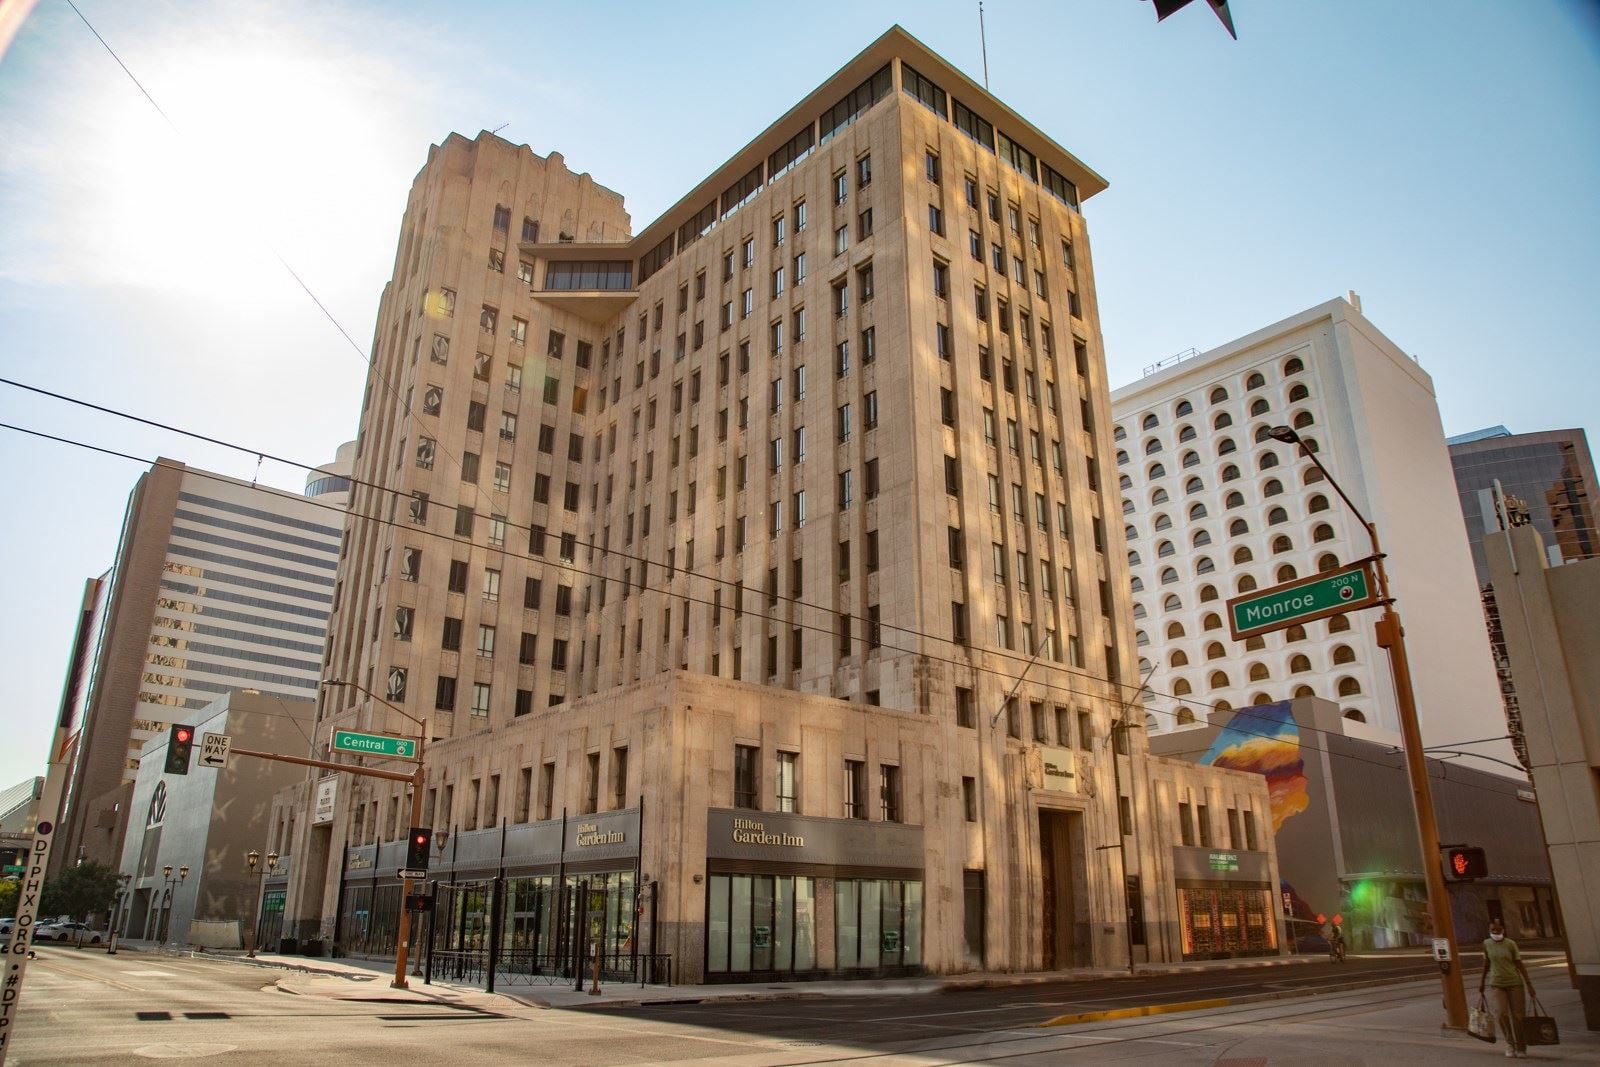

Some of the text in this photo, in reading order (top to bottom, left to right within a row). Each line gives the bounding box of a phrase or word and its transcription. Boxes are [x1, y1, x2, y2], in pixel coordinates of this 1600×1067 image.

[1331, 574, 1359, 588] 200 N
[1246, 594, 1314, 622] Monroe
[207, 735, 228, 746] ONE
[343, 736, 385, 751] Central
[204, 745, 227, 756] WAY
[734, 818, 764, 831] Hilton
[576, 830, 624, 847] Garden Inn
[733, 829, 804, 847] Garden Inn
